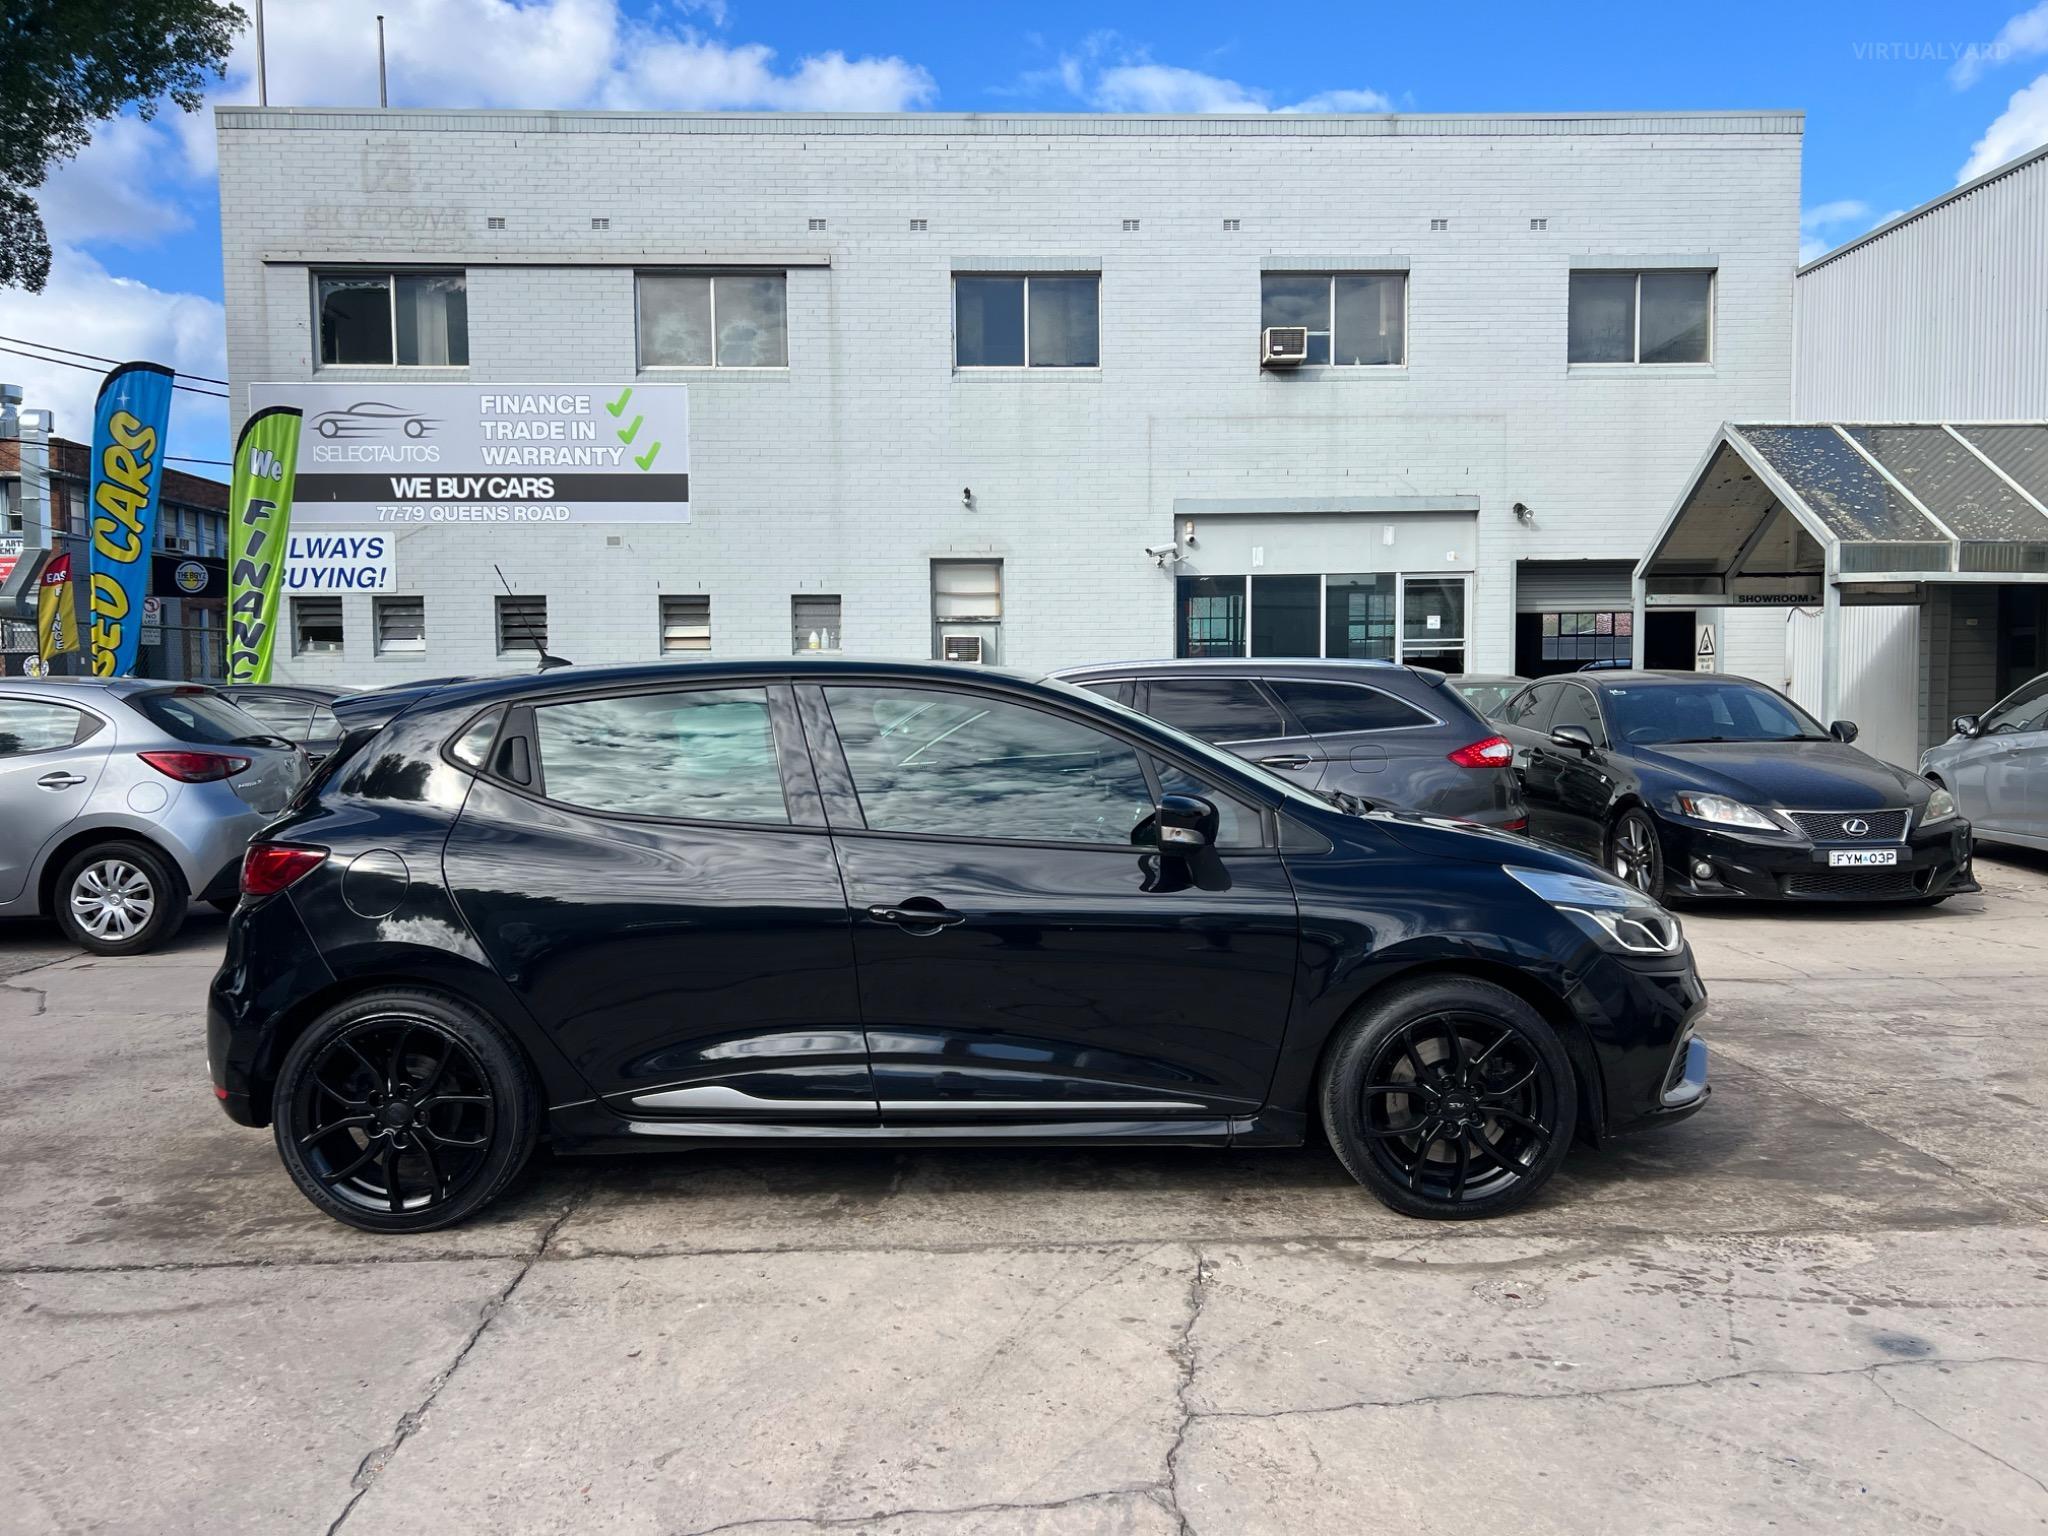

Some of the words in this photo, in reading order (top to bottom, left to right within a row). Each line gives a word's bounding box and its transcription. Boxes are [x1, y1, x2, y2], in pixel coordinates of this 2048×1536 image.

[480, 395, 590, 414] FINANCE
[480, 421, 565, 440] TRADE
[571, 421, 596, 440] IN
[313, 445, 440, 462] ISELECTAUTOS
[481, 447, 625, 466] WARRANTY
[250, 448, 282, 482] We
[94, 410, 157, 563] CARS
[390, 477, 432, 498] WE
[437, 477, 487, 498] BUY
[487, 477, 555, 498] CARS
[376, 506, 425, 521] 77-79
[430, 506, 510, 522] QUEENS
[514, 506, 570, 521] ROAD
[289, 537, 385, 559] LWAYS
[46, 570, 67, 583] EAS
[230, 499, 276, 678] FINANC
[1738, 595, 1809, 603] SHOWROOM
[91, 572, 130, 677] SED
[1837, 854, 1862, 865] FYM
